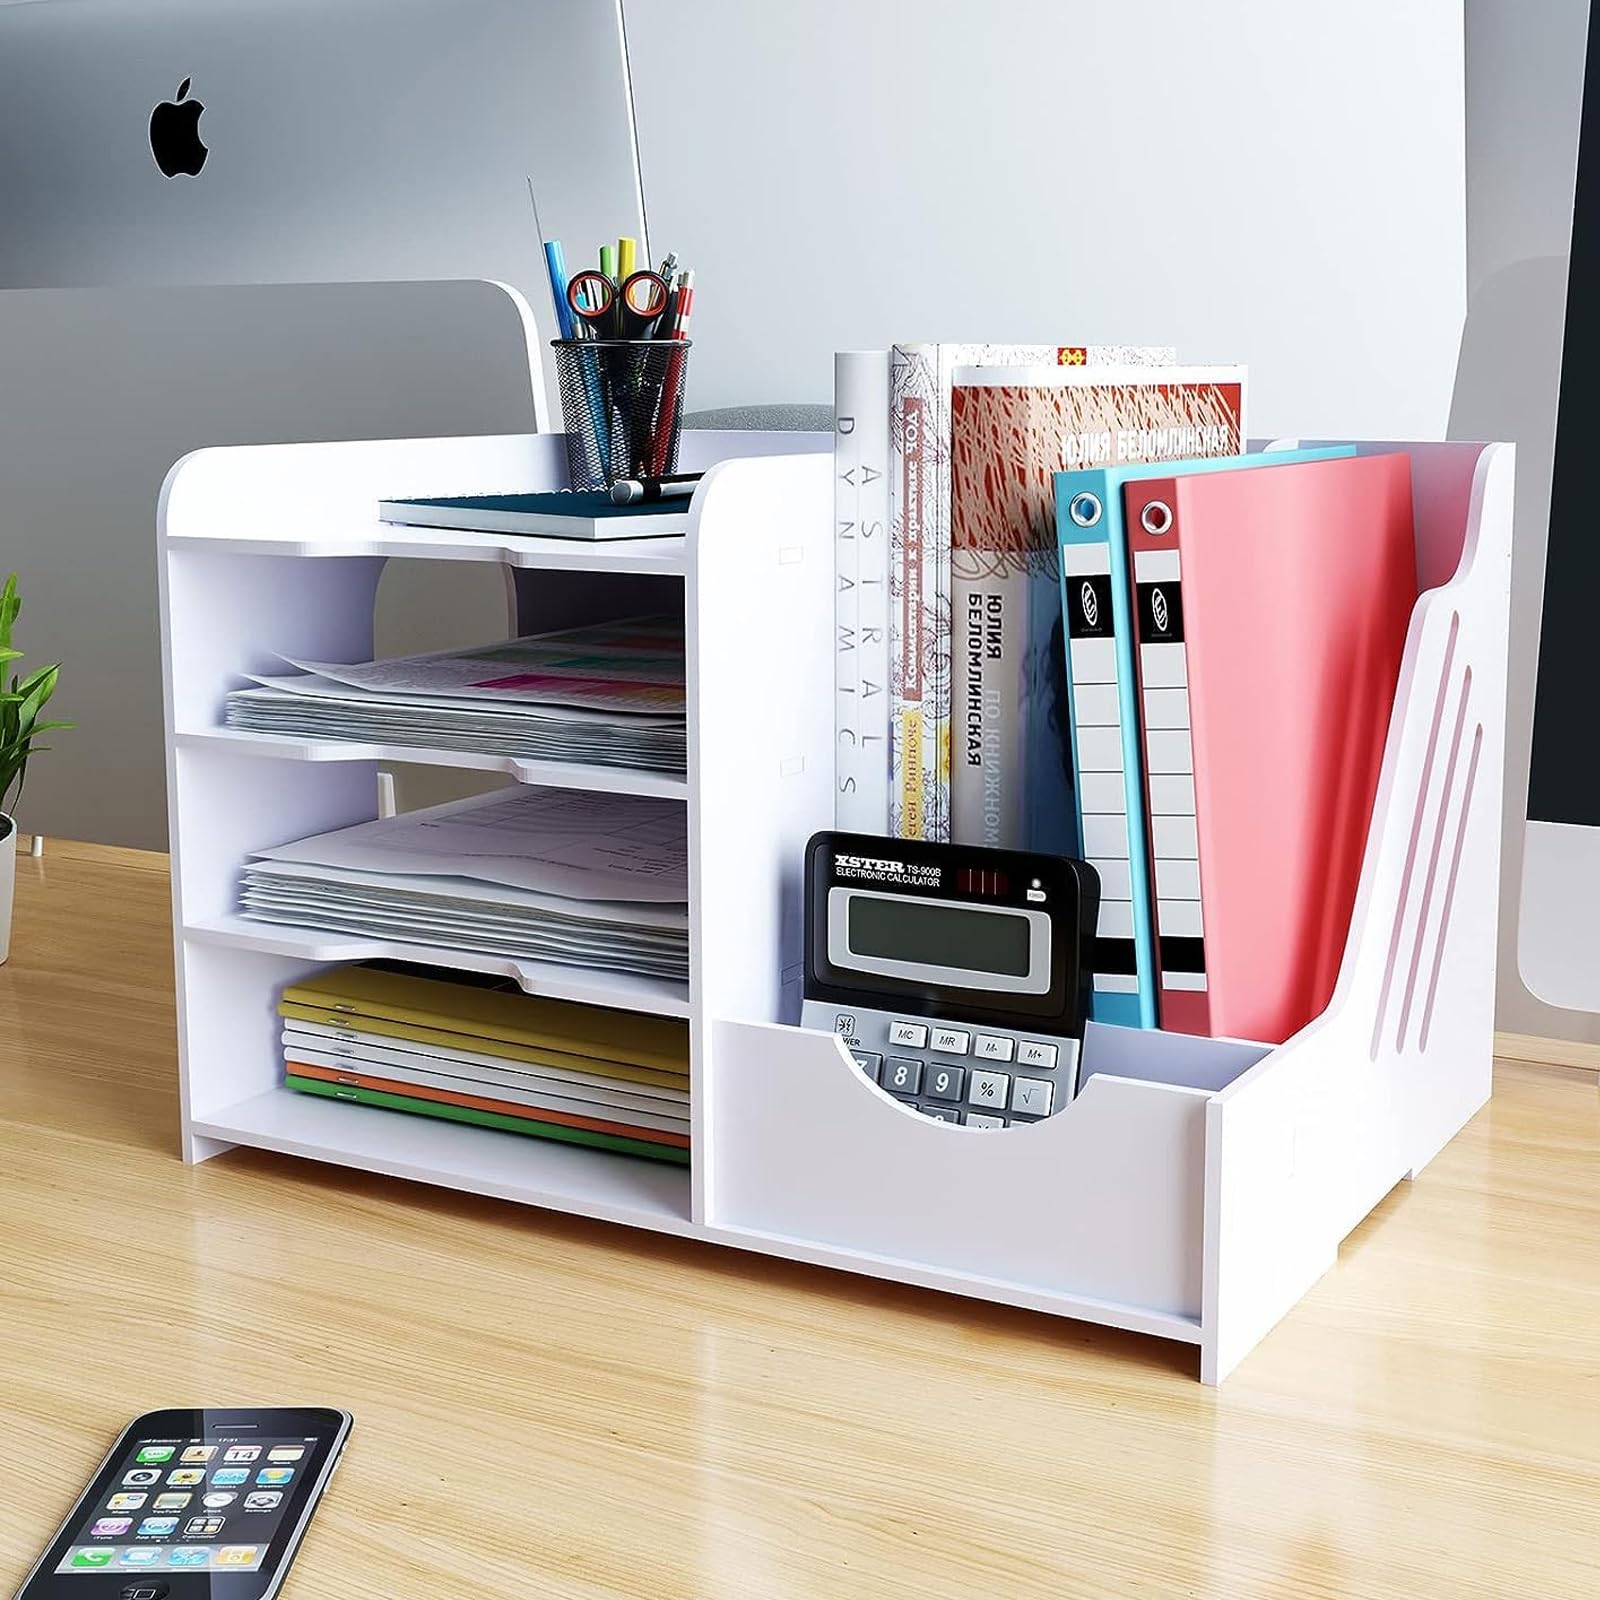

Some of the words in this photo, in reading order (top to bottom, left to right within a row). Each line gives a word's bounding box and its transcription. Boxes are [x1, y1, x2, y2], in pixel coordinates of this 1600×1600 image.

[1062, 432, 1110, 464] ЮЛИЯ
[1117, 424, 1229, 460] БЕЛОМЛИНСКАЯ
[836, 416, 857, 795] DYNAMICS
[860, 464, 884, 749] ASTRAL
[986, 594, 1002, 660] ЮЛИЯ
[967, 593, 983, 766] БЕЛОМЛИНСКАЯ
[984, 729, 1001, 847] КНИЖНОМ
[836, 866, 886, 881] ELECTRONIC
[887, 872, 940, 887] CALCULATOR
[842, 1036, 861, 1047] WER
[897, 1029, 914, 1040] MC
[939, 1035, 955, 1047] MR
[1027, 1048, 1042, 1059] M+
[894, 1066, 908, 1086] 8
[935, 1072, 950, 1093] 9
[231, 1451, 253, 1460] 14
